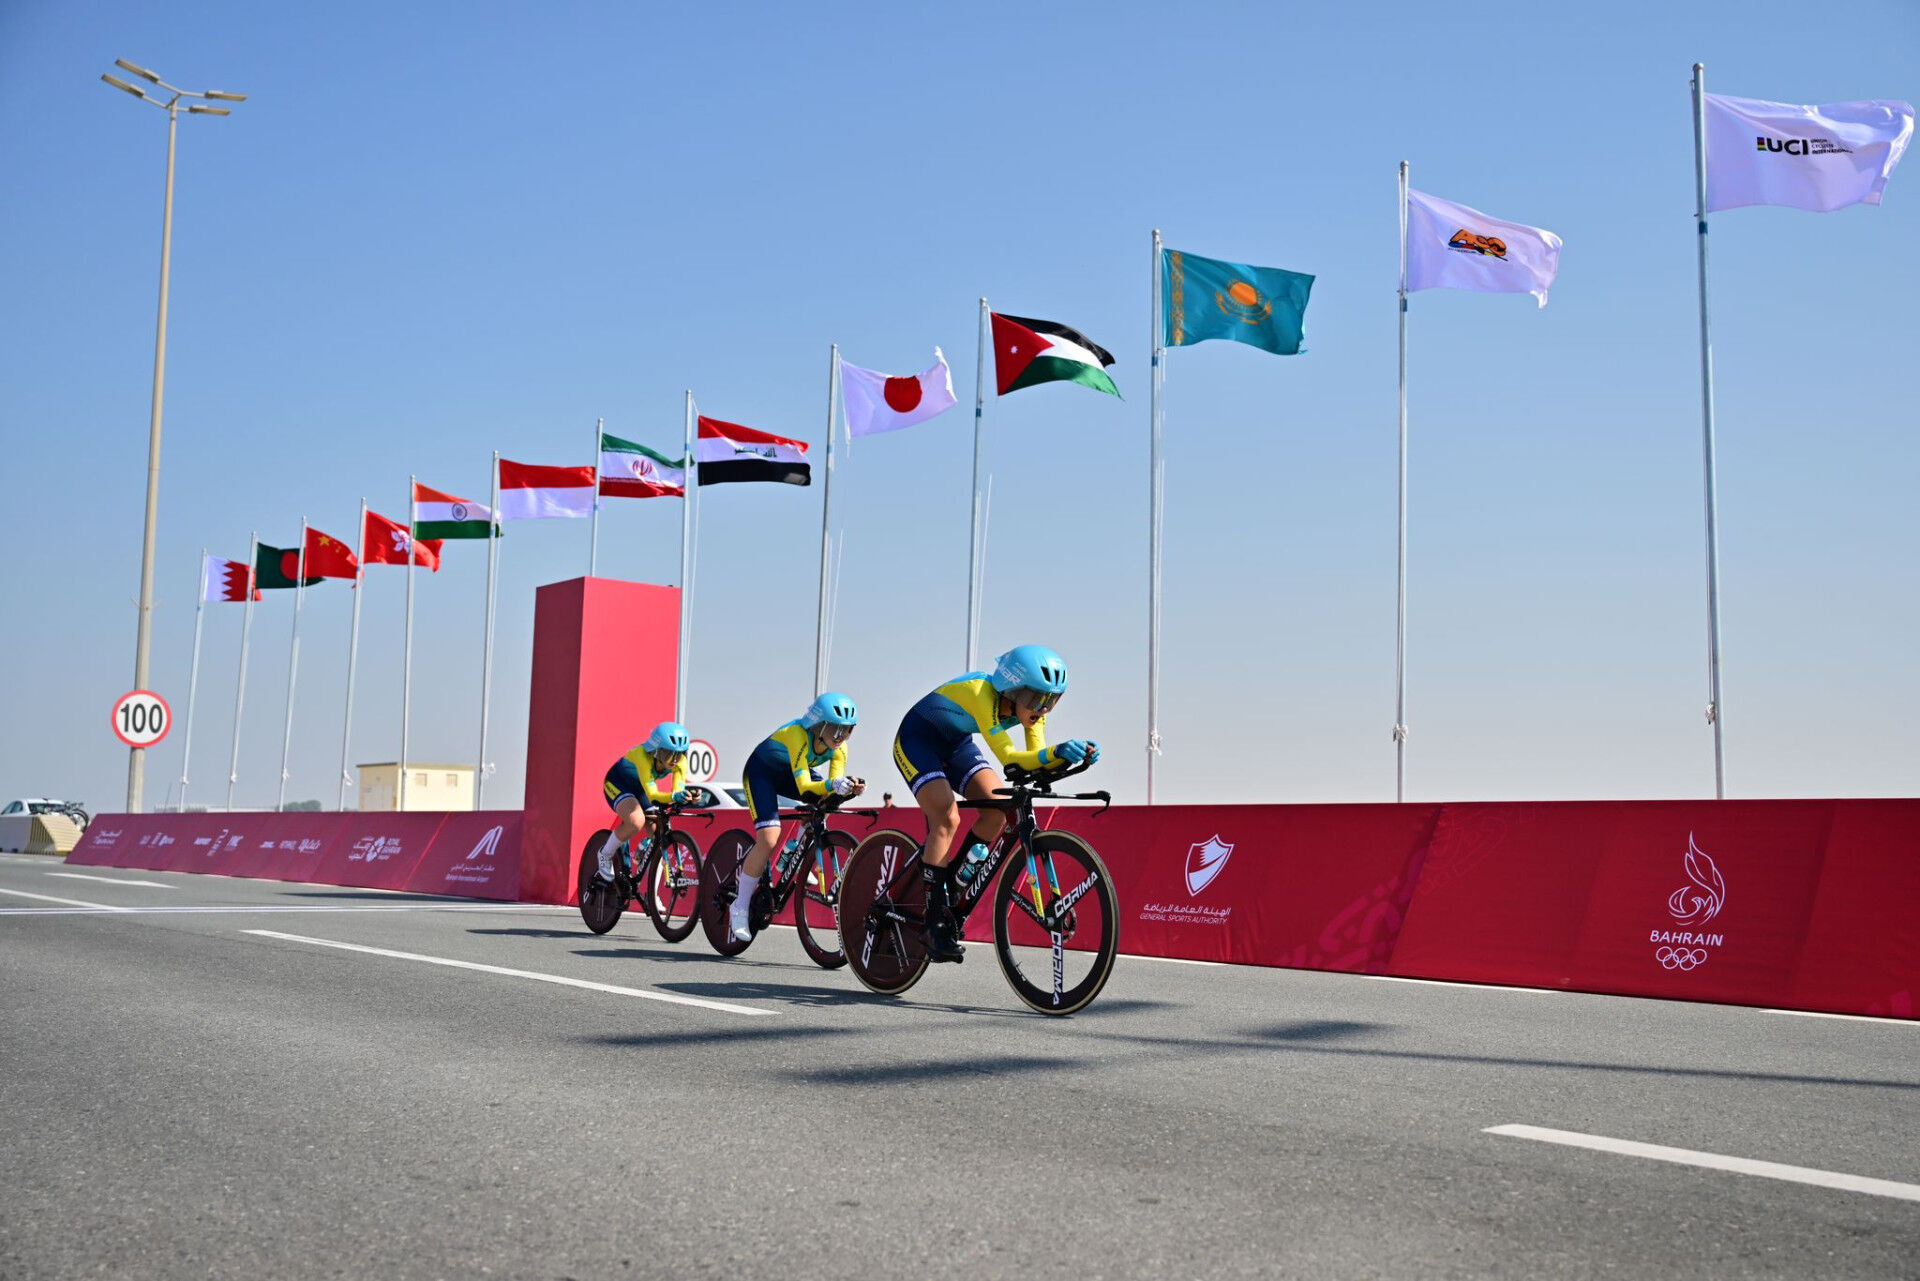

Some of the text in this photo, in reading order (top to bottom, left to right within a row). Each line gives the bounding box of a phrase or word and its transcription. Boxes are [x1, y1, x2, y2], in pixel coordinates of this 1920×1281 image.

[1766, 138, 1809, 155] UCI
[120, 703, 163, 733] 100
[689, 750, 712, 775] 00
[1054, 871, 1098, 918] CORIMA
[1140, 913, 1228, 925] GENERAL SPORTS AUTHORITY
[1650, 930, 1724, 947] BAHRAIN
[1051, 930, 1063, 1005] CORIMA
